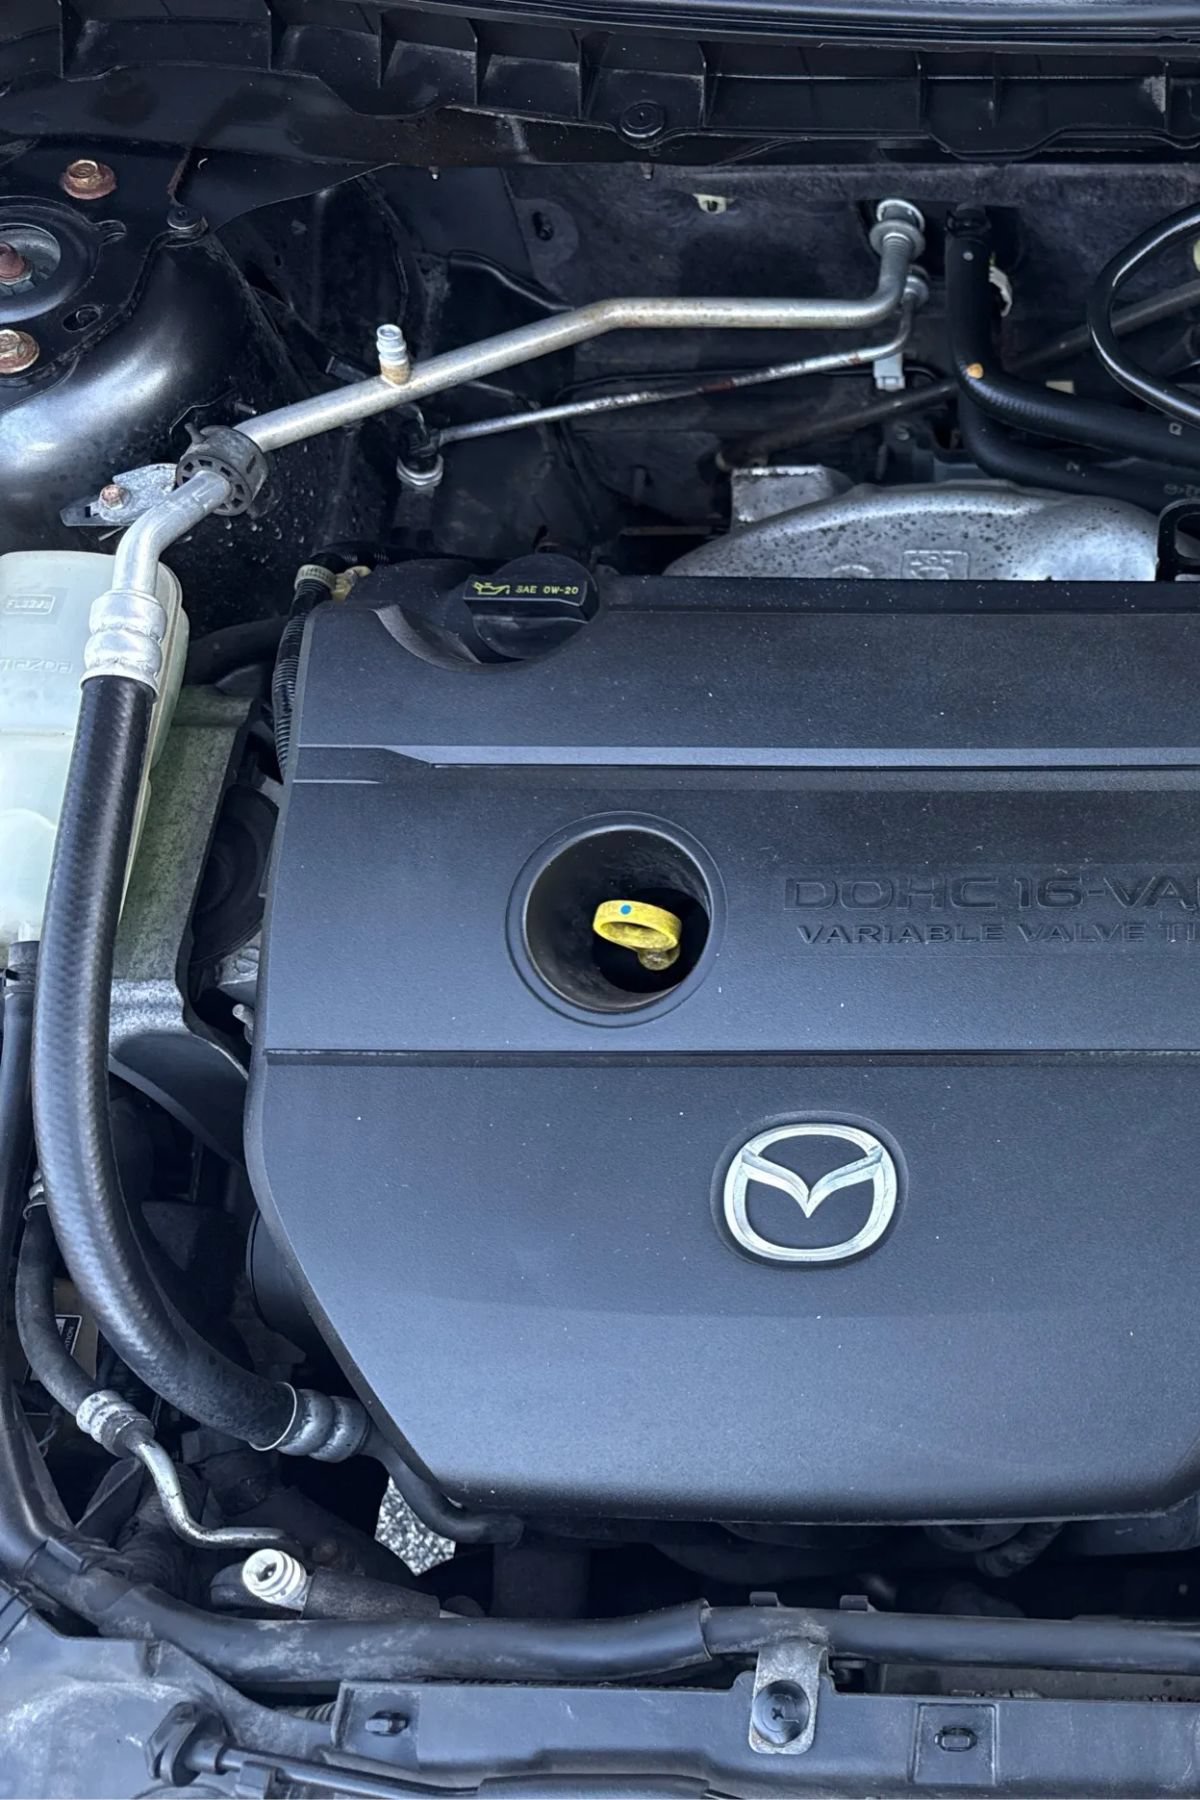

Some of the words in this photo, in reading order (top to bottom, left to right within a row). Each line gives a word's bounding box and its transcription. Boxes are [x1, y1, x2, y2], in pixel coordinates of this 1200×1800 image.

[516, 585, 537, 594] SAE
[543, 585, 579, 595] 0W-20
[784, 877, 1000, 911] DOHC
[797, 923, 1006, 945] VARIABLE
[1017, 923, 1147, 943] VALVE
